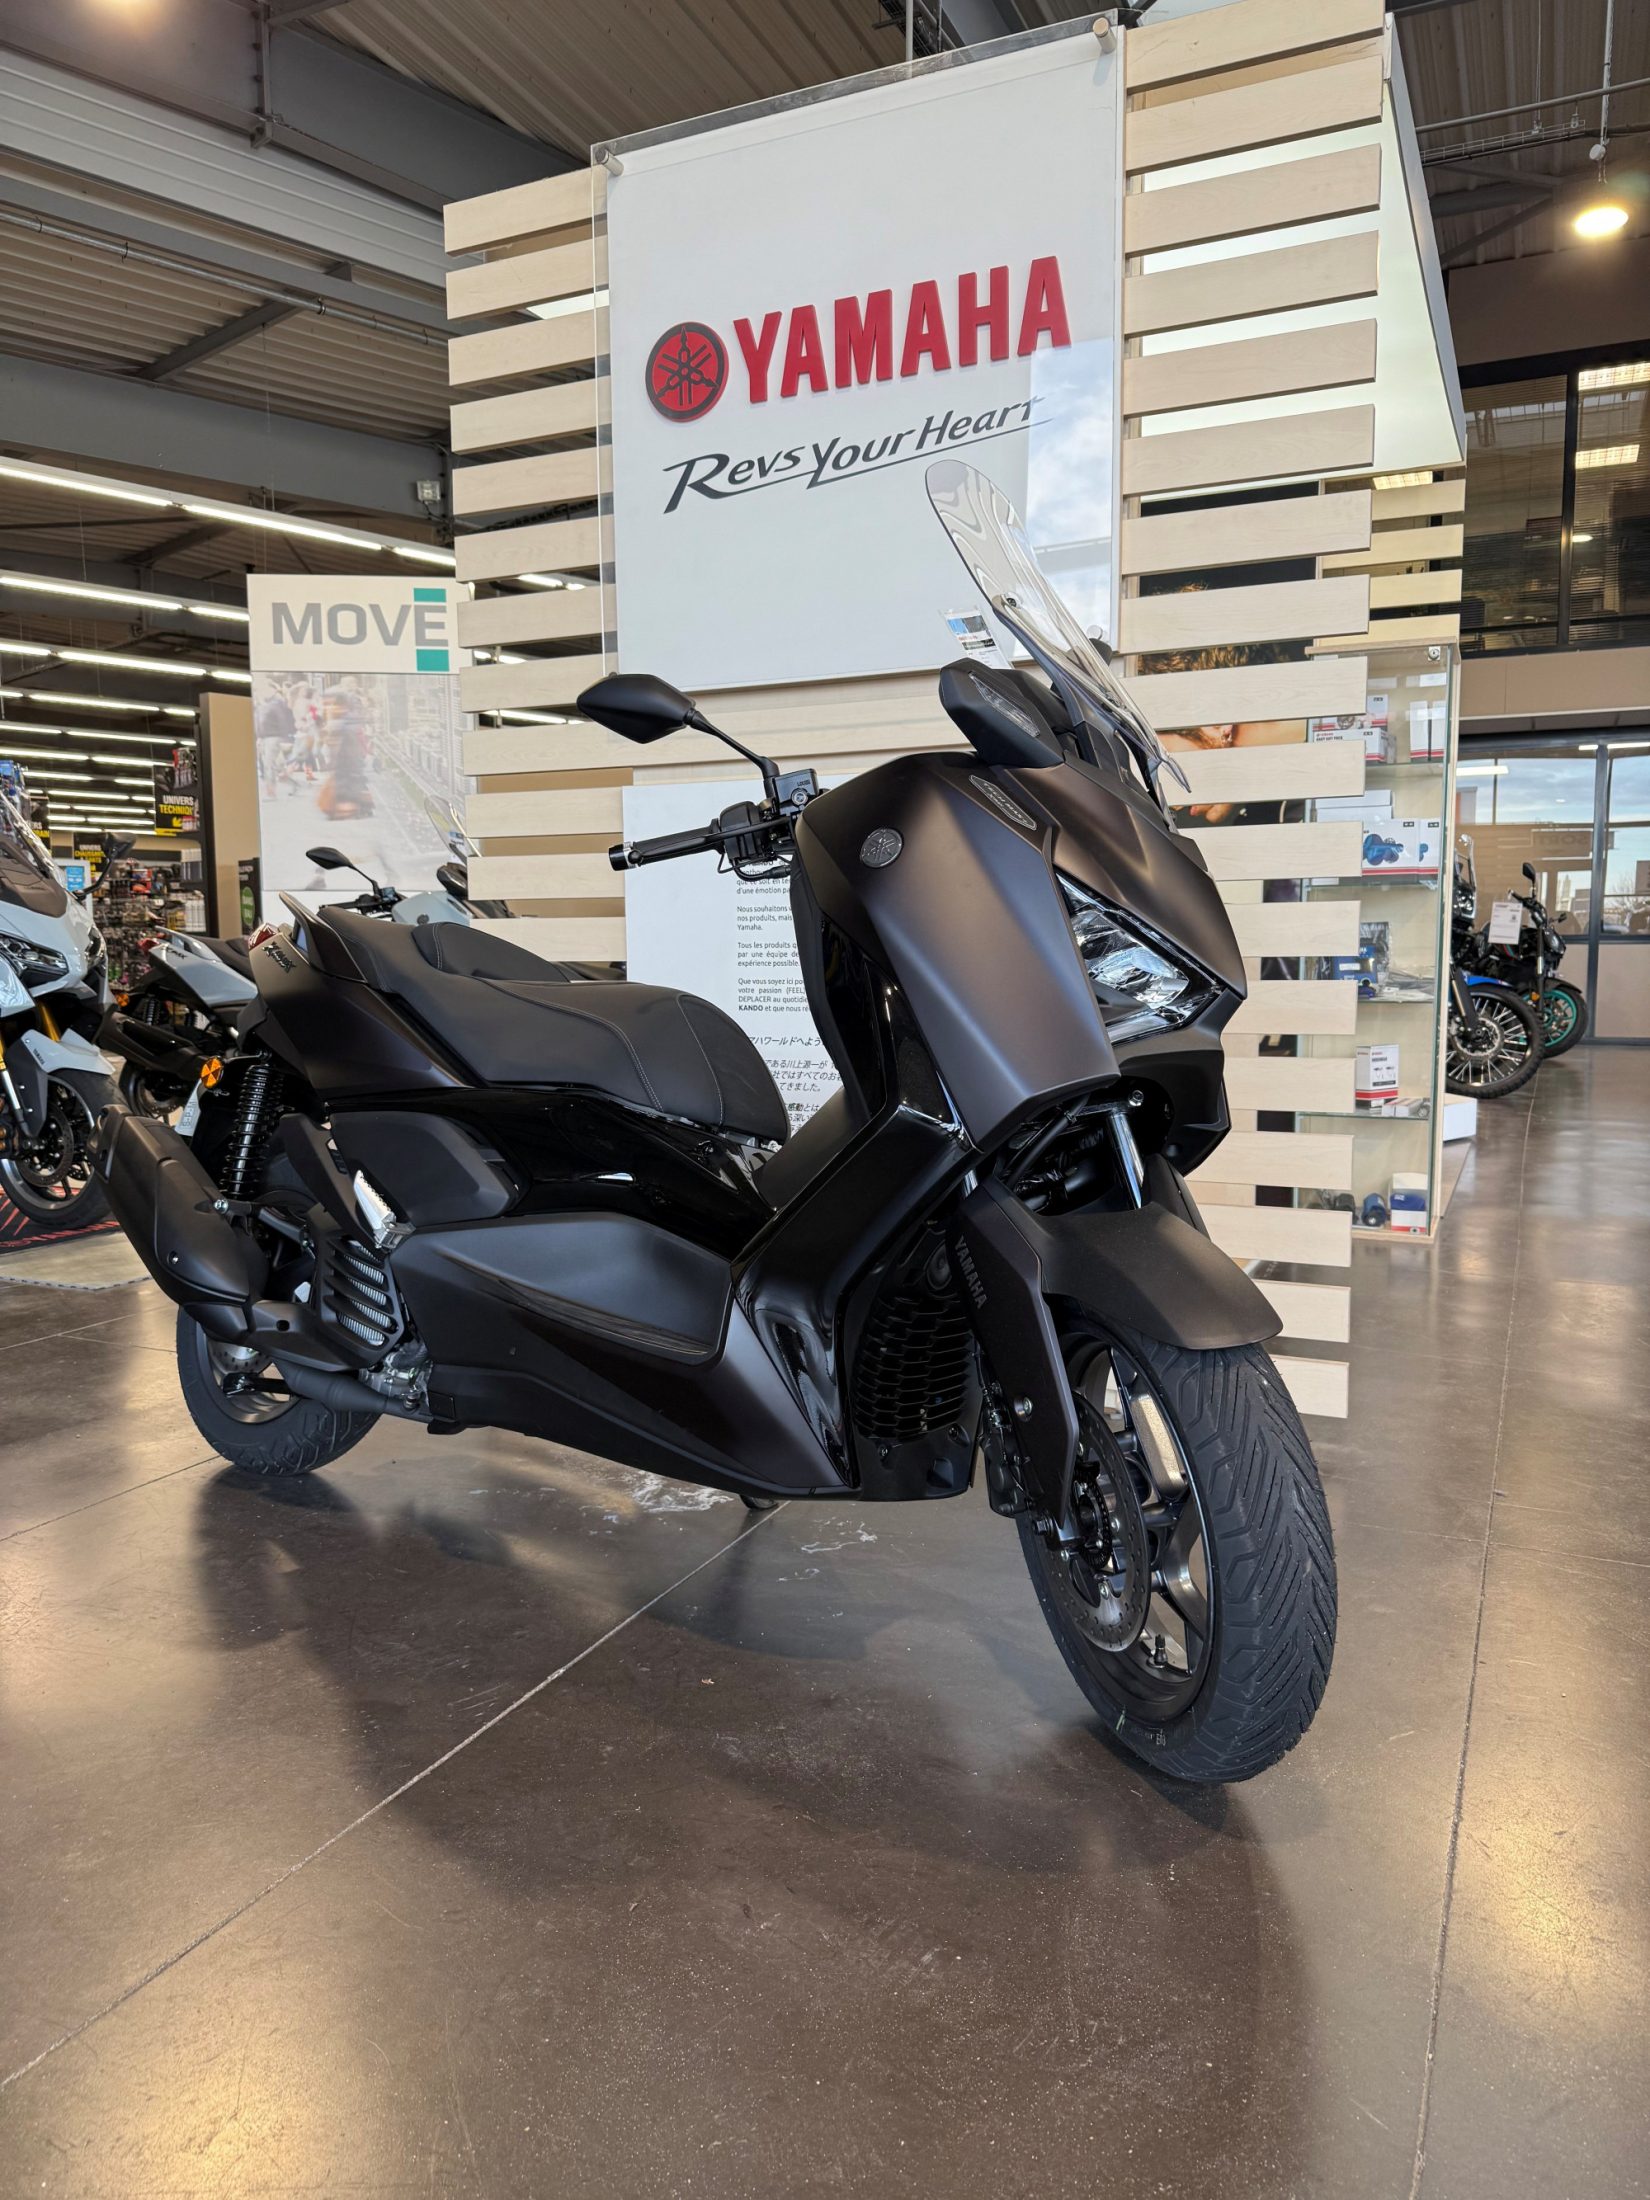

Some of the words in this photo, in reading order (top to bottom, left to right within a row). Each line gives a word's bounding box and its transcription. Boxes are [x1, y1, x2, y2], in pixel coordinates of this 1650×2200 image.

[733, 255, 1072, 404] YAMAHA
[662, 446, 806, 513] Revs
[806, 429, 916, 489] Your
[915, 396, 1046, 450] Heart
[271, 602, 449, 647] MOVE
[163, 795, 194, 806] UNIVERS
[753, 905, 788, 913] souhaitons
[764, 941, 791, 949] produits
[954, 1234, 988, 1310] YAMAHA
